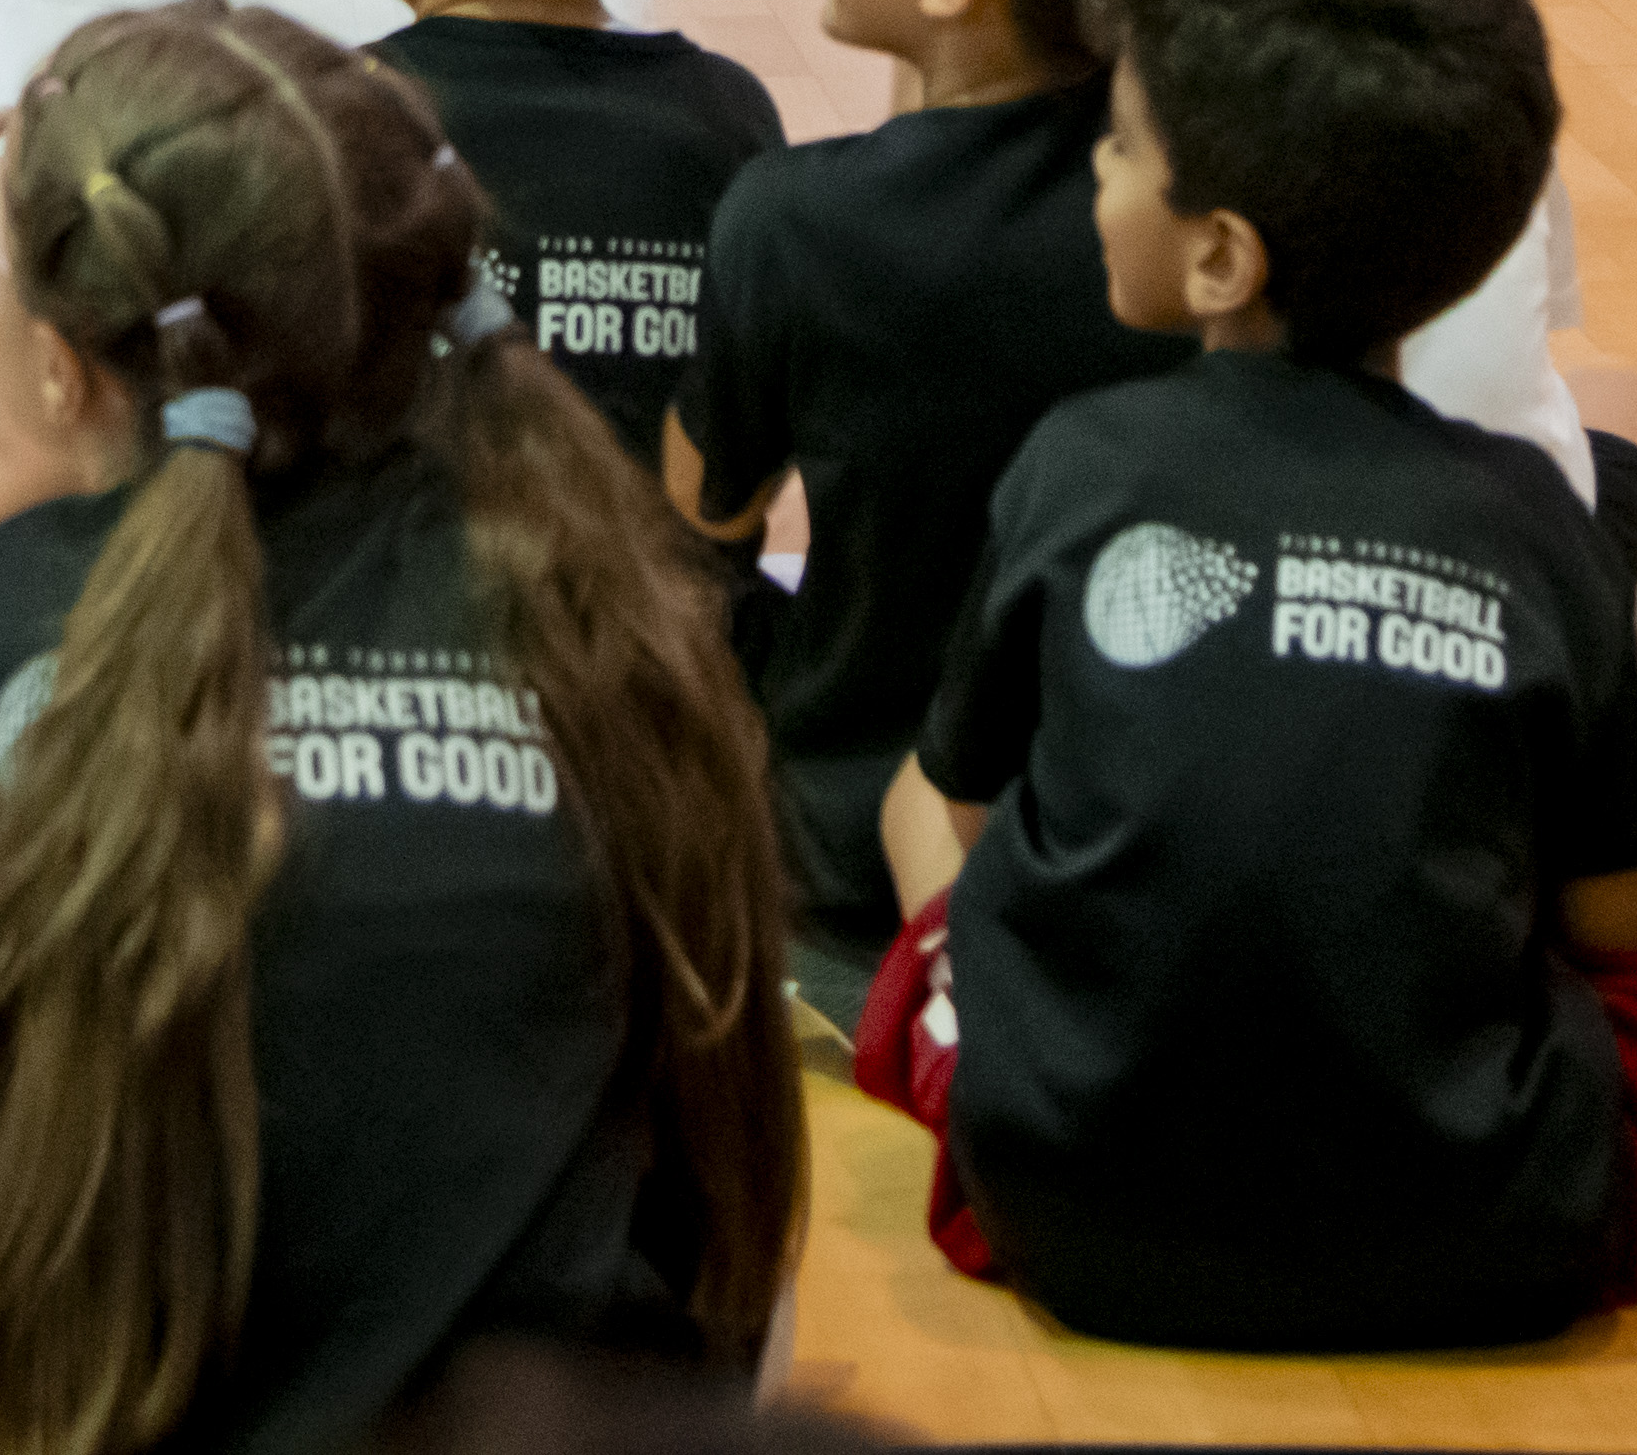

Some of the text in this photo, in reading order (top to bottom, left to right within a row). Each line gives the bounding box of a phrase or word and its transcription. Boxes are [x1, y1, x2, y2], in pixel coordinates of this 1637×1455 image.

[538, 302, 623, 354] FOR
[1277, 557, 1506, 641] BASKETBALL
[1274, 601, 1506, 688] FOR GOOD
[398, 732, 558, 815] GOOD
